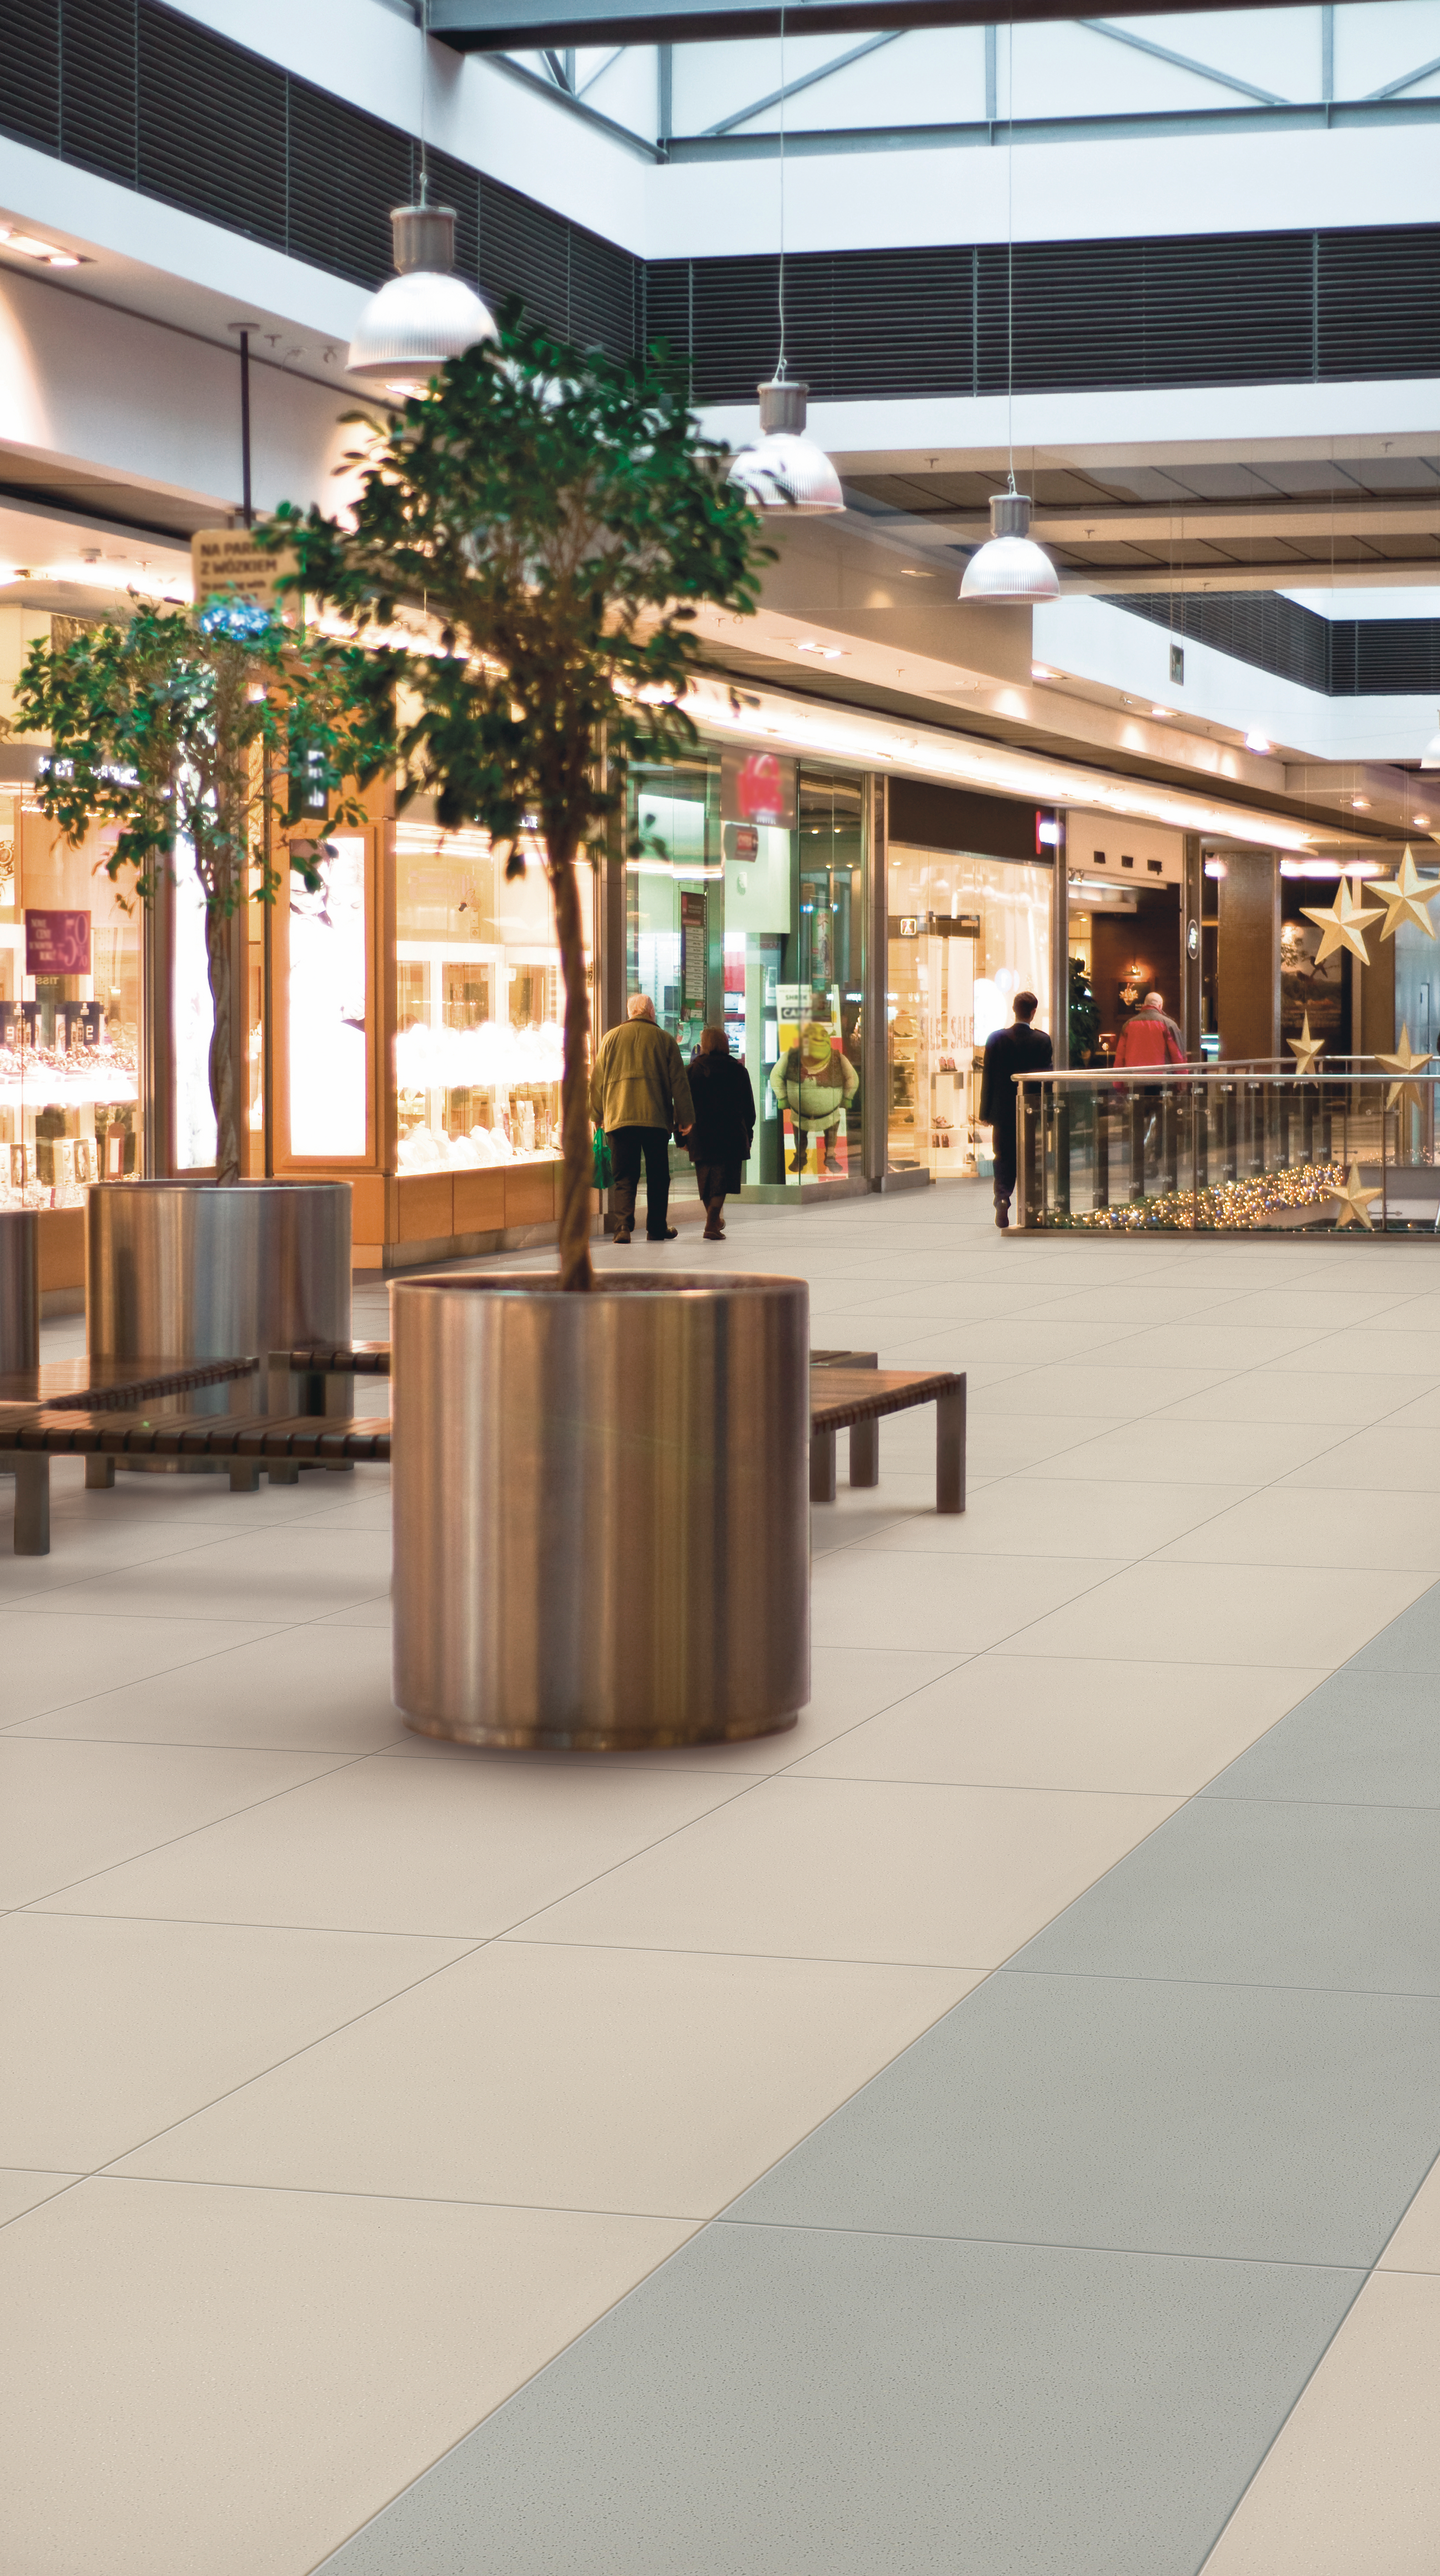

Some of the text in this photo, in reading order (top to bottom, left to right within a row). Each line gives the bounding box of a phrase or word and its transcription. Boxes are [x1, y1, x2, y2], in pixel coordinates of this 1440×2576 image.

[200, 543, 221, 556] NA
[200, 557, 278, 575] Z WÓZKIEM
